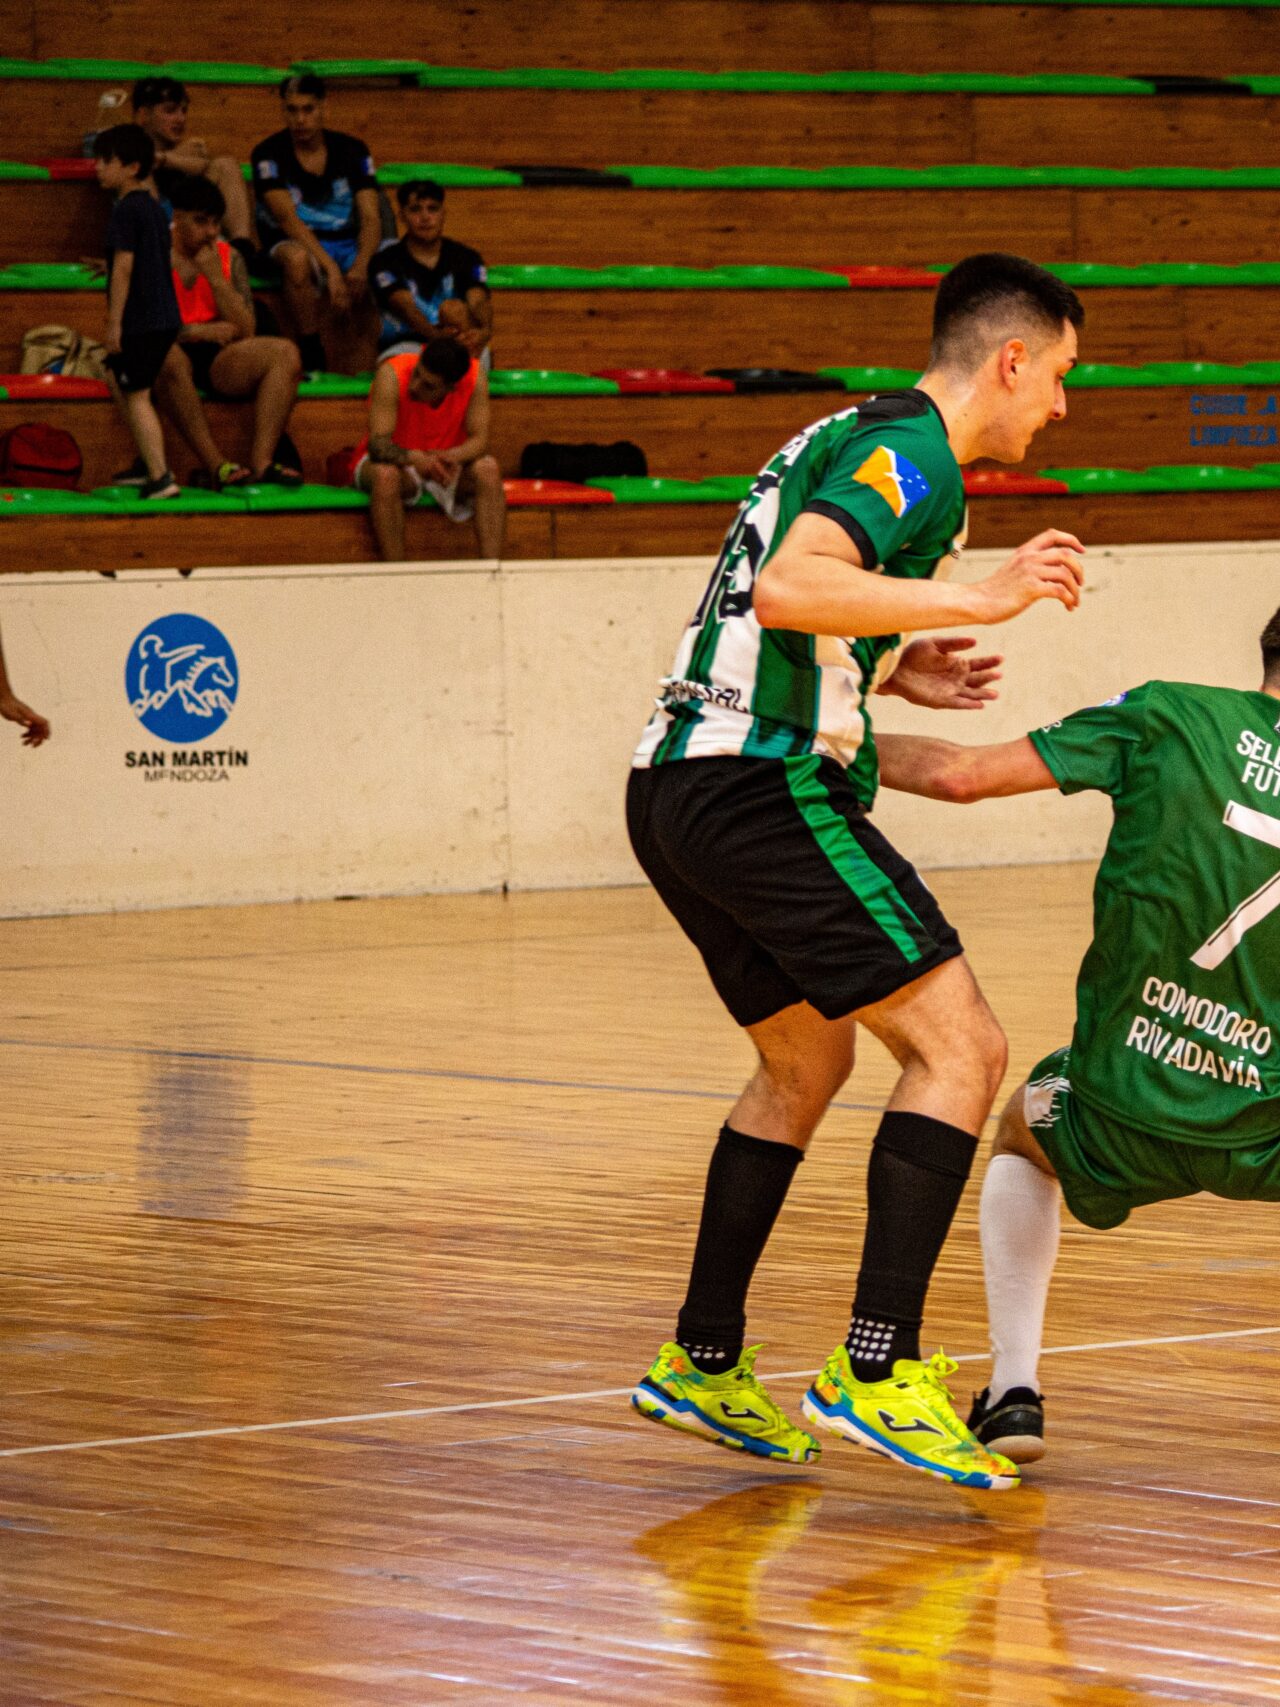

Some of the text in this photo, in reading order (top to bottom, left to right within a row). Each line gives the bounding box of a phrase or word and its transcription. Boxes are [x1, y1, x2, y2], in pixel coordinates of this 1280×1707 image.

[125, 746, 248, 768] SAN MARTÍN
[144, 768, 230, 782] MENDOZA
[1142, 976, 1272, 1056] COMODORO
